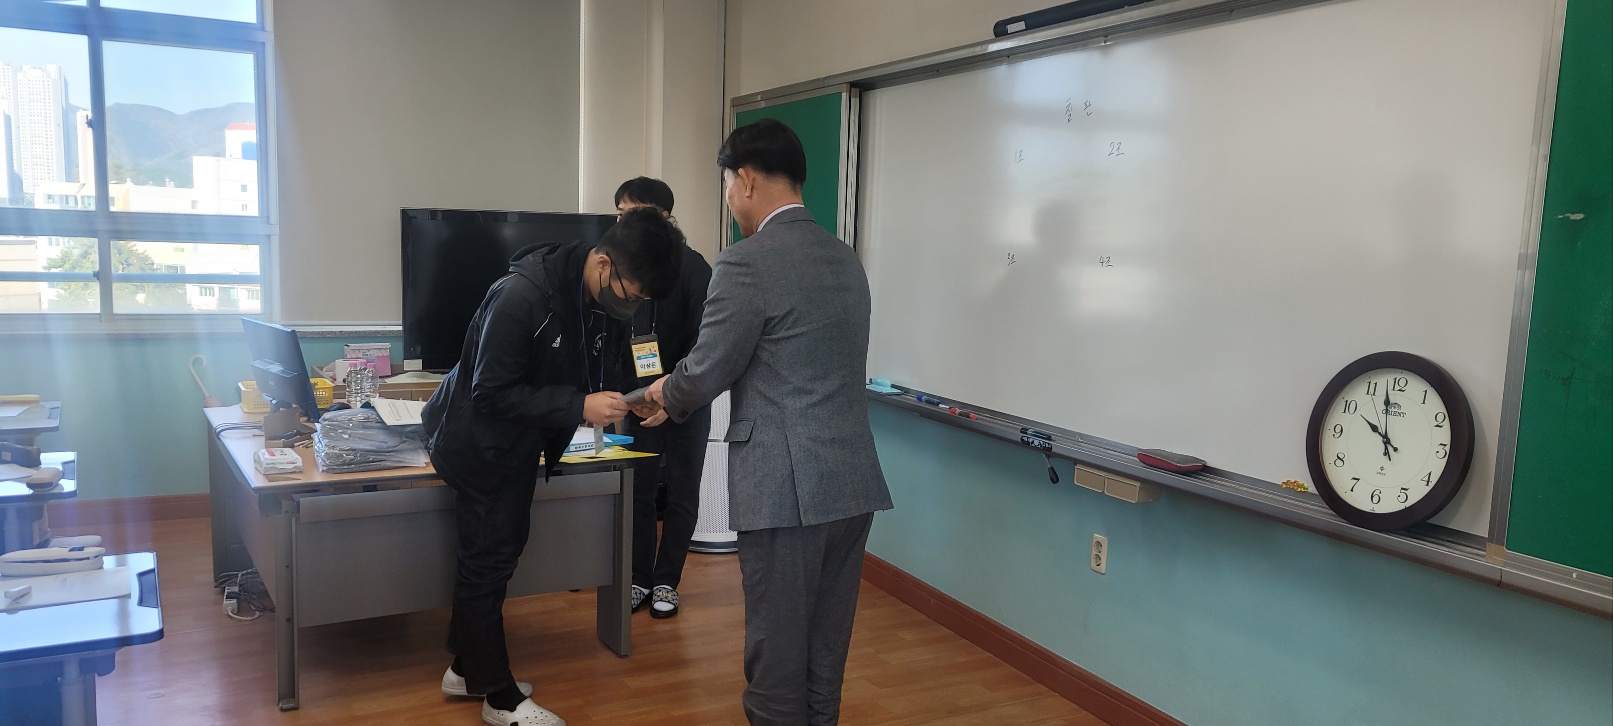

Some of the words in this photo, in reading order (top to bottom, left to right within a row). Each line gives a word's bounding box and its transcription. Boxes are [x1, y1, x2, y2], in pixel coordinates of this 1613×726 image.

[1365, 380, 1378, 396] 11
[1391, 376, 1409, 393] 12
[1420, 389, 1428, 405] 1
[1341, 399, 1358, 415] 10
[1381, 408, 1407, 418] ORIENT
[1433, 411, 1446, 429] 2
[1332, 423, 1344, 439] 9
[1435, 442, 1448, 460] 3
[1333, 452, 1346, 468] 8
[1350, 476, 1361, 493] 7
[1420, 471, 1433, 487] 4
[1370, 488, 1382, 505] 6
[1396, 487, 1410, 504] 5
